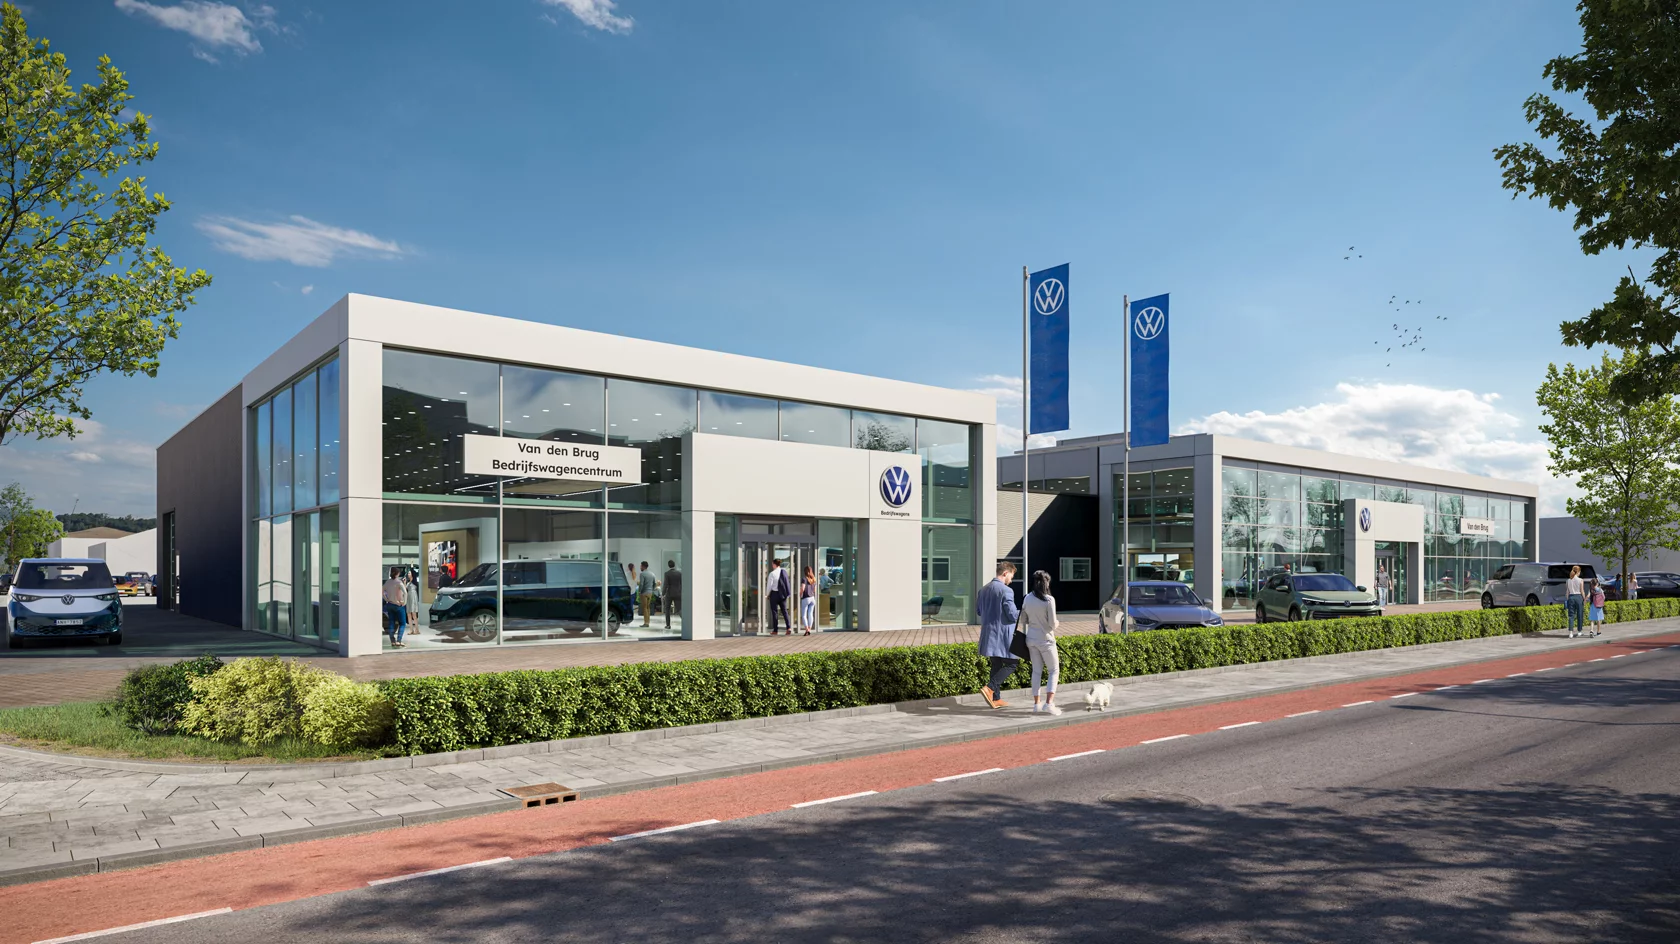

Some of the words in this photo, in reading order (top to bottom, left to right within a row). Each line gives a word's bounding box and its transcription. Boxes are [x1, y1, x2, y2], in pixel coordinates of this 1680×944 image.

[518, 443, 541, 454] Van
[546, 445, 568, 456] den
[573, 447, 599, 460] Brug
[492, 459, 622, 477] Bedrijfswagencentrum
